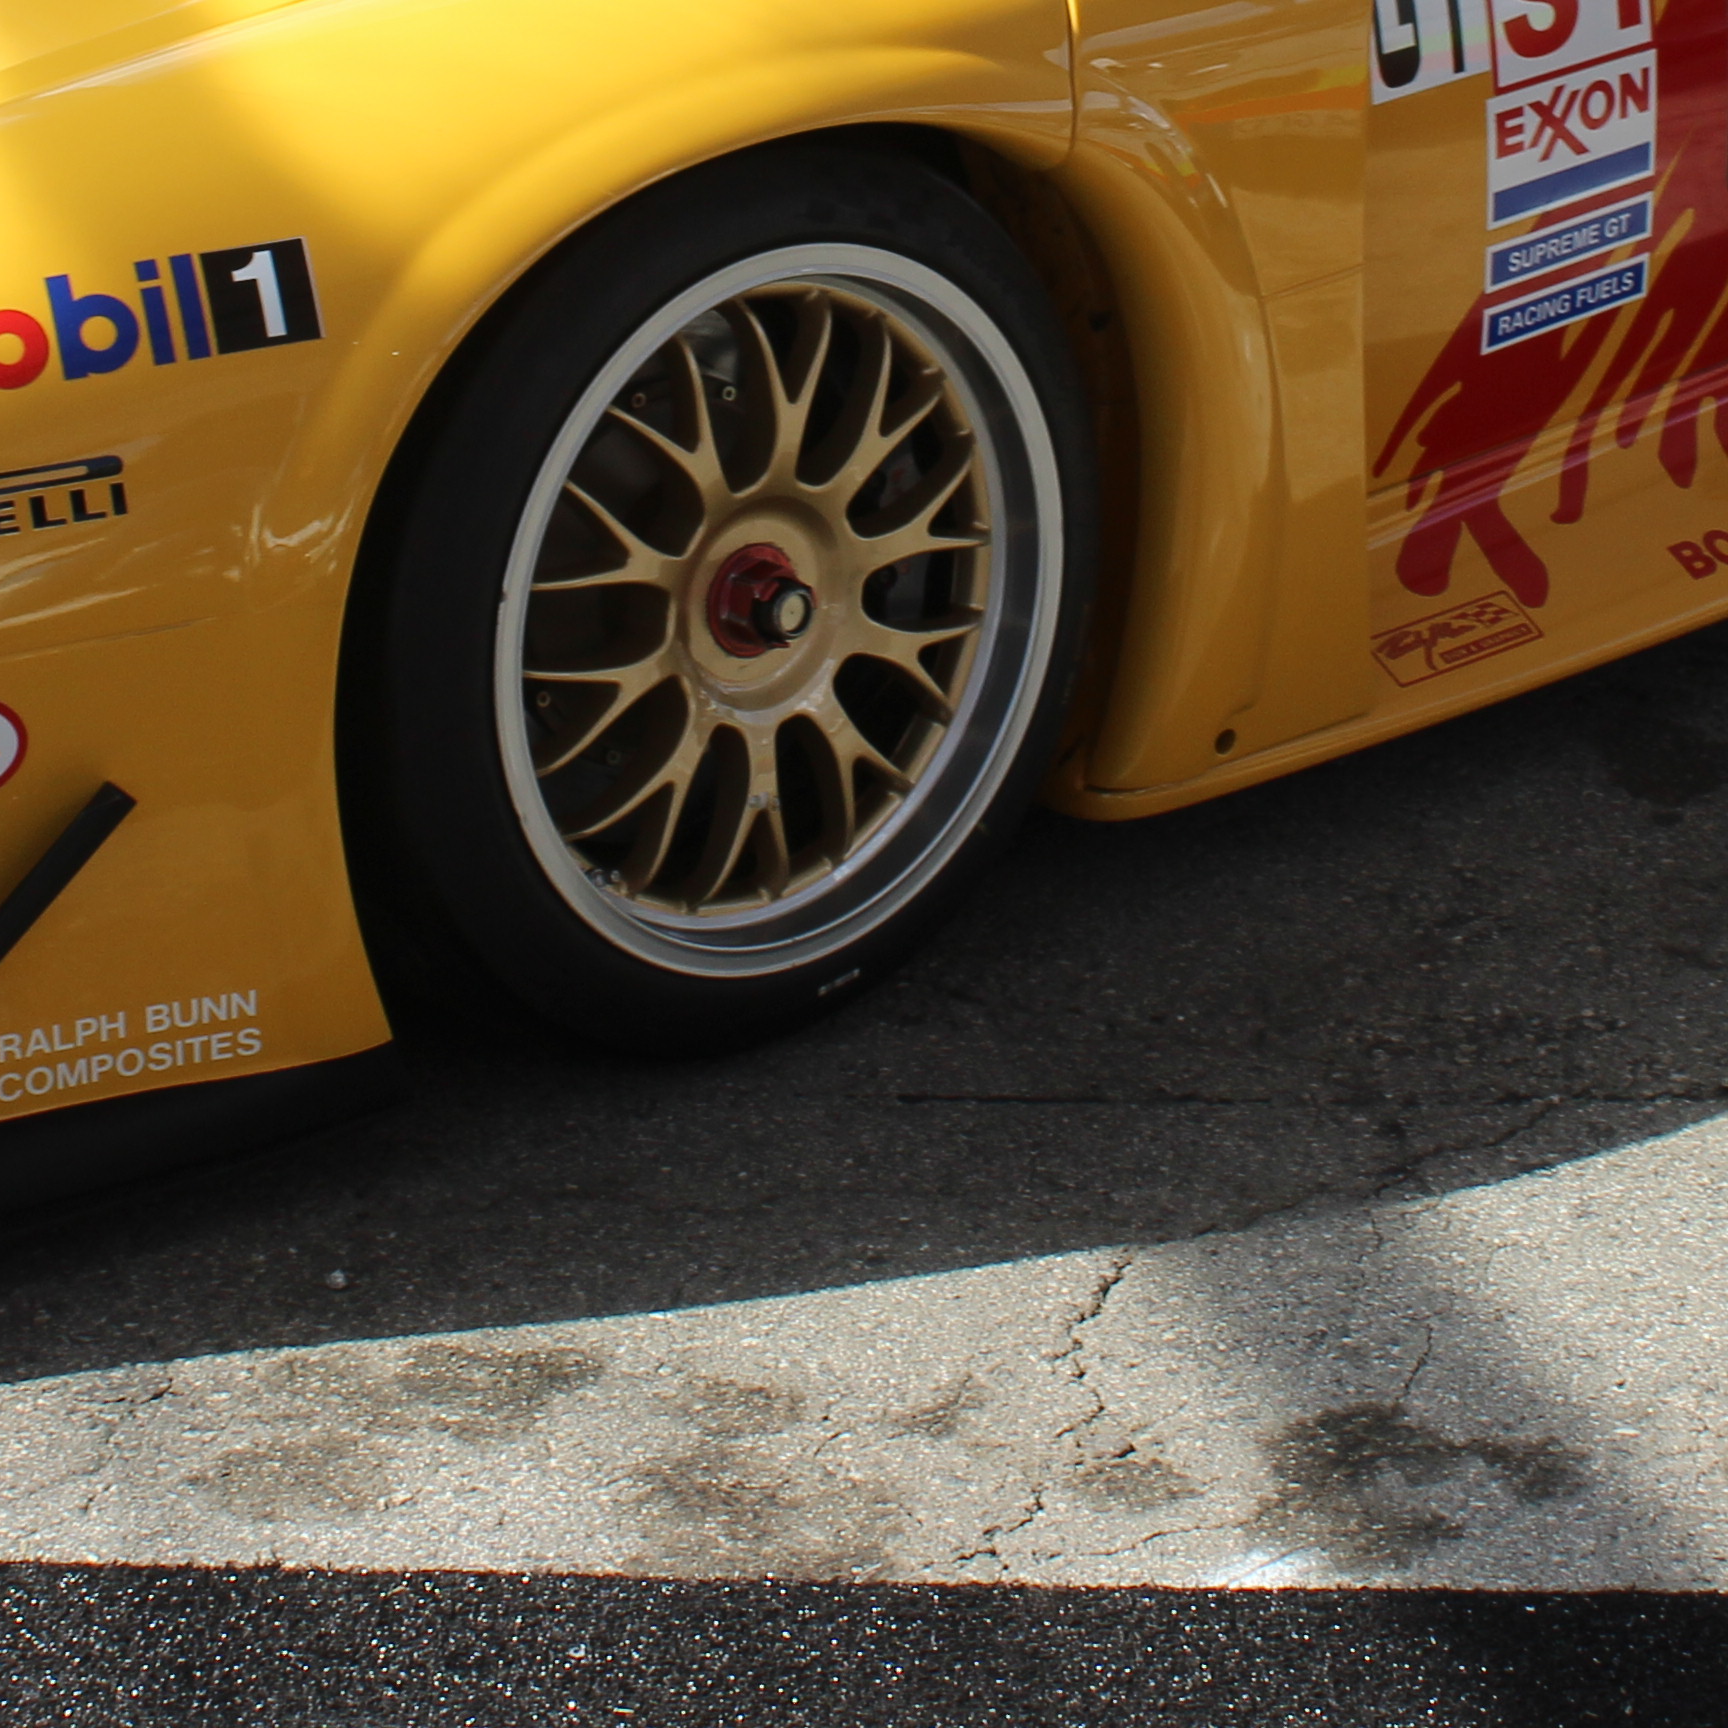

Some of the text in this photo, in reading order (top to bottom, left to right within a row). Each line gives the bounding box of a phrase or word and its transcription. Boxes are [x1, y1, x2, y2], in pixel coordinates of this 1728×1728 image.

[1493, 66, 1651, 163] EXXON
[1507, 212, 1632, 273] SUPREME GT
[231, 249, 289, 338] 1
[1497, 271, 1635, 337] RACING FUELS
[144, 989, 259, 1034] BUNN
